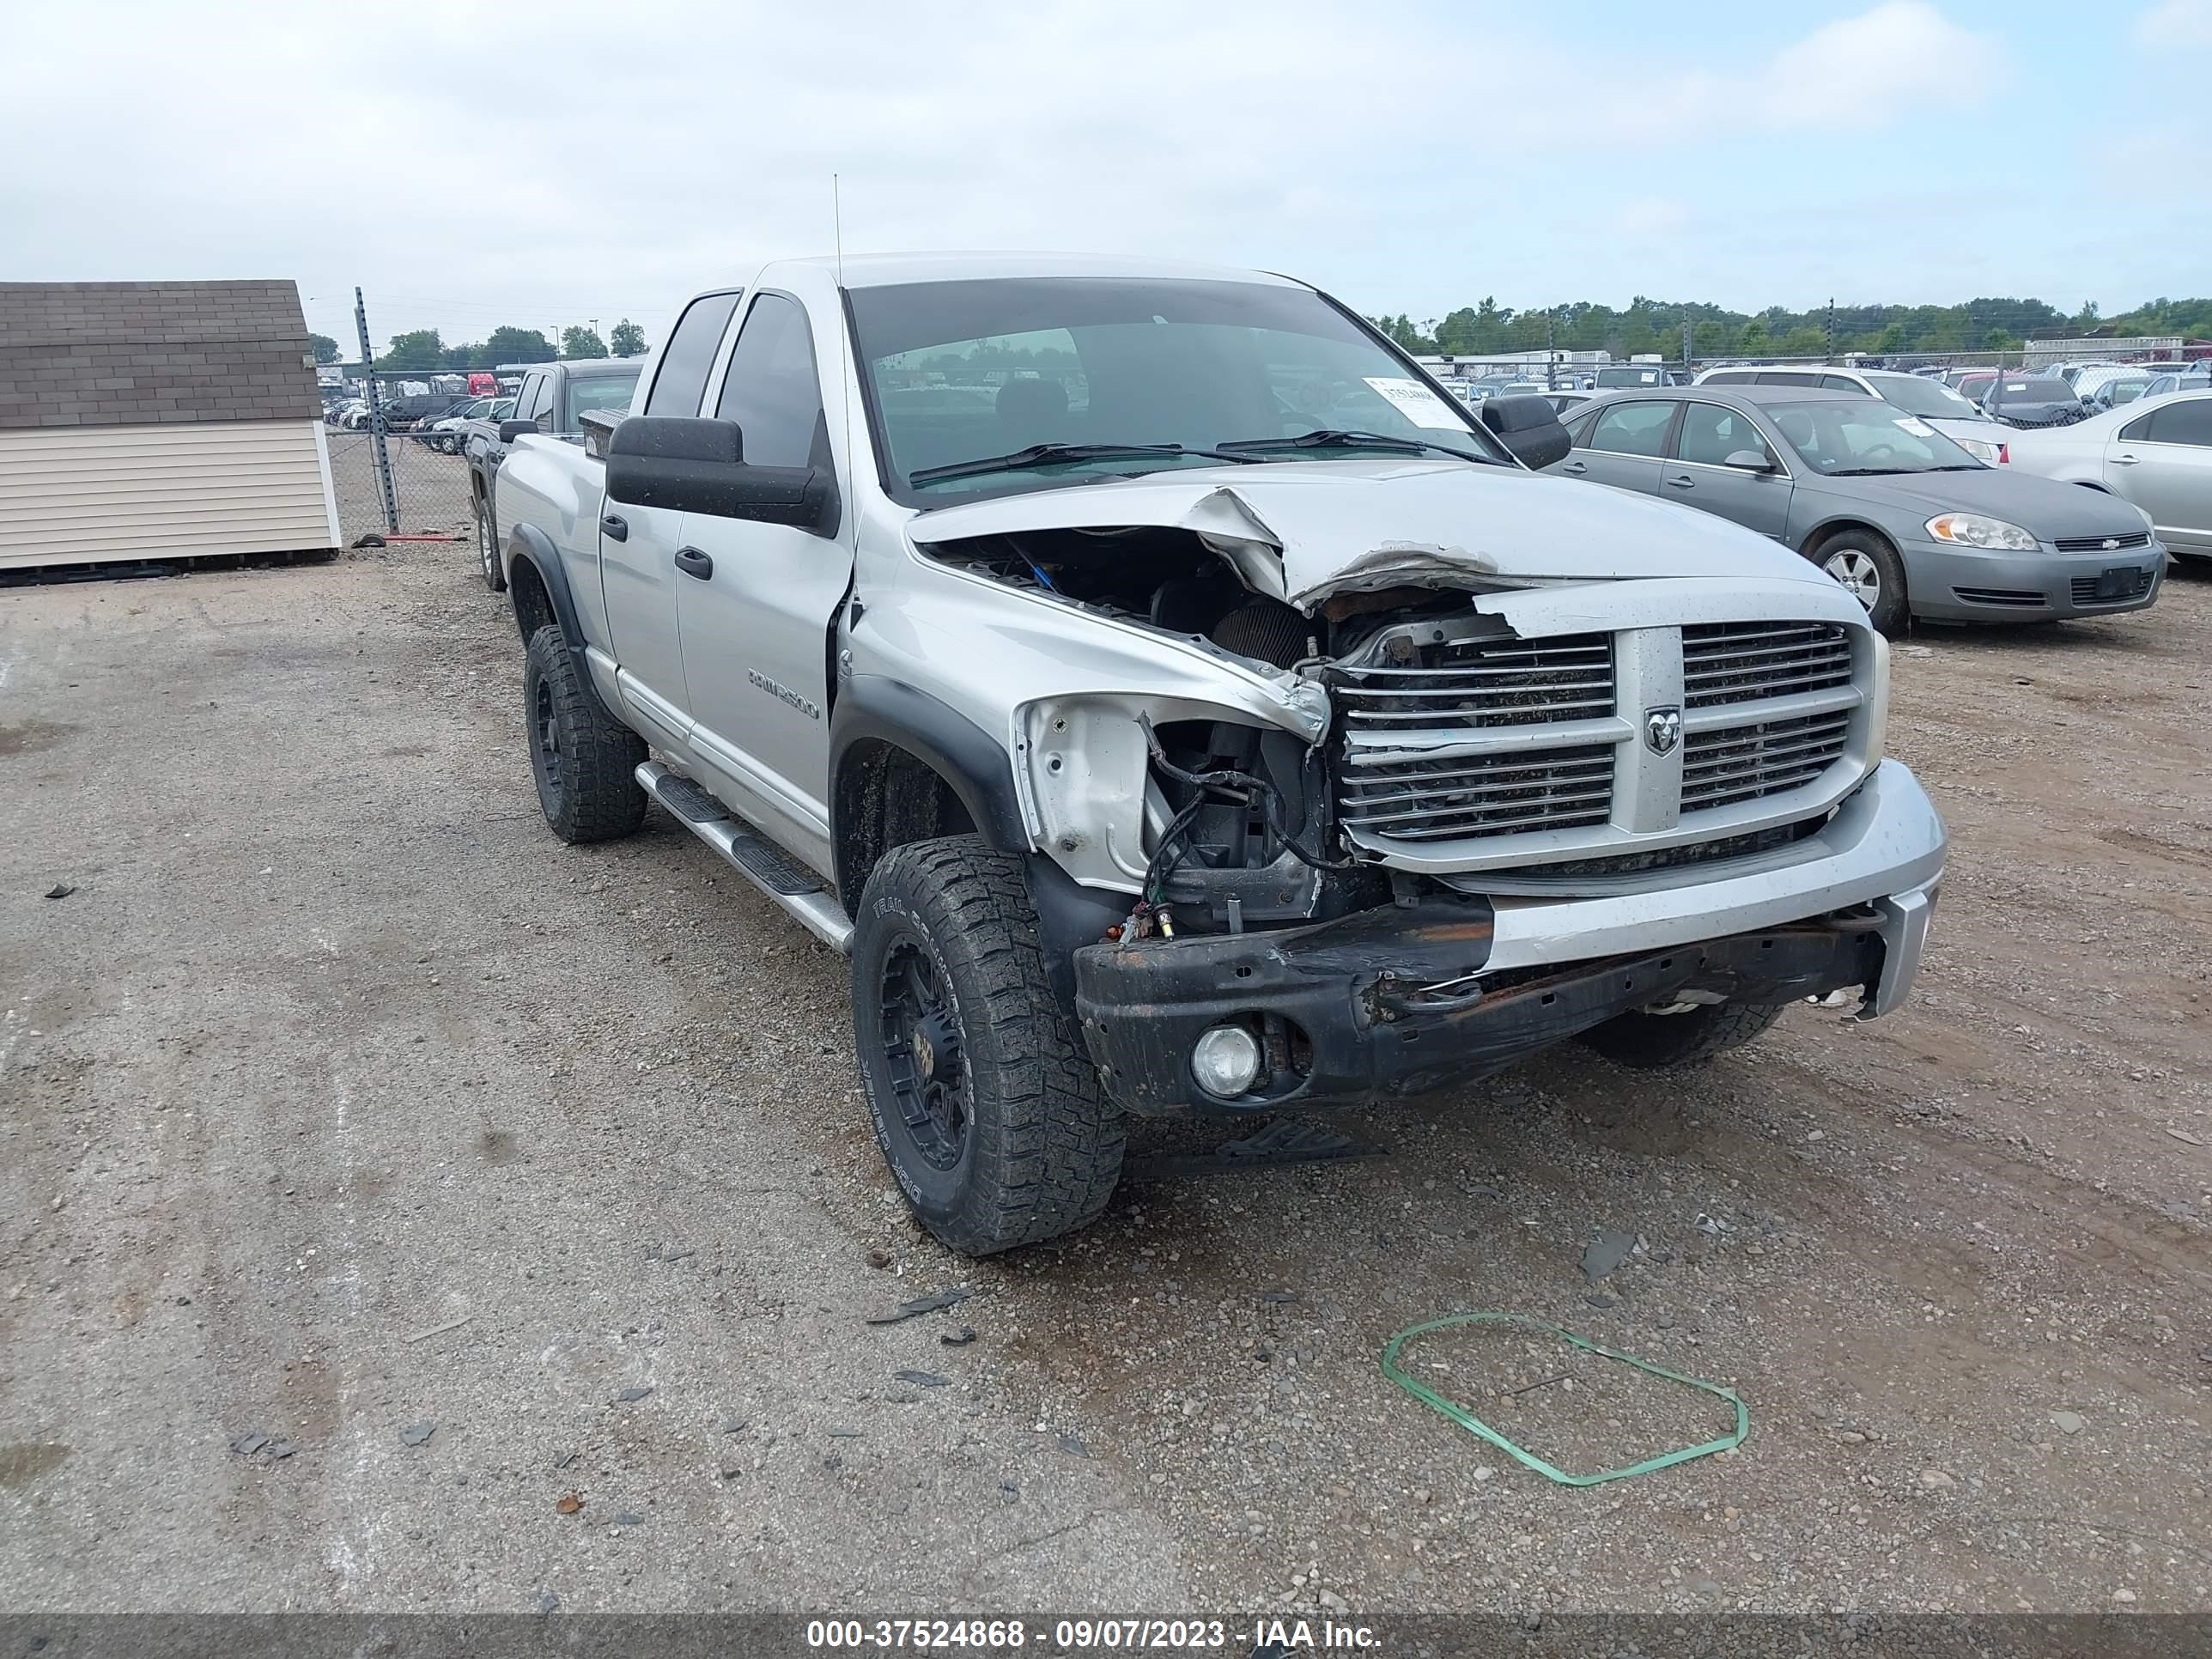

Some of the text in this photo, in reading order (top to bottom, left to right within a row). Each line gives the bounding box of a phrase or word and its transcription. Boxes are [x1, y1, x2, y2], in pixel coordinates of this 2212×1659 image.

[872, 896, 907, 919] TRAIL
[911, 910, 967, 1039] COUNTRY
[860, 1058, 922, 1204] DICK CEPEK
